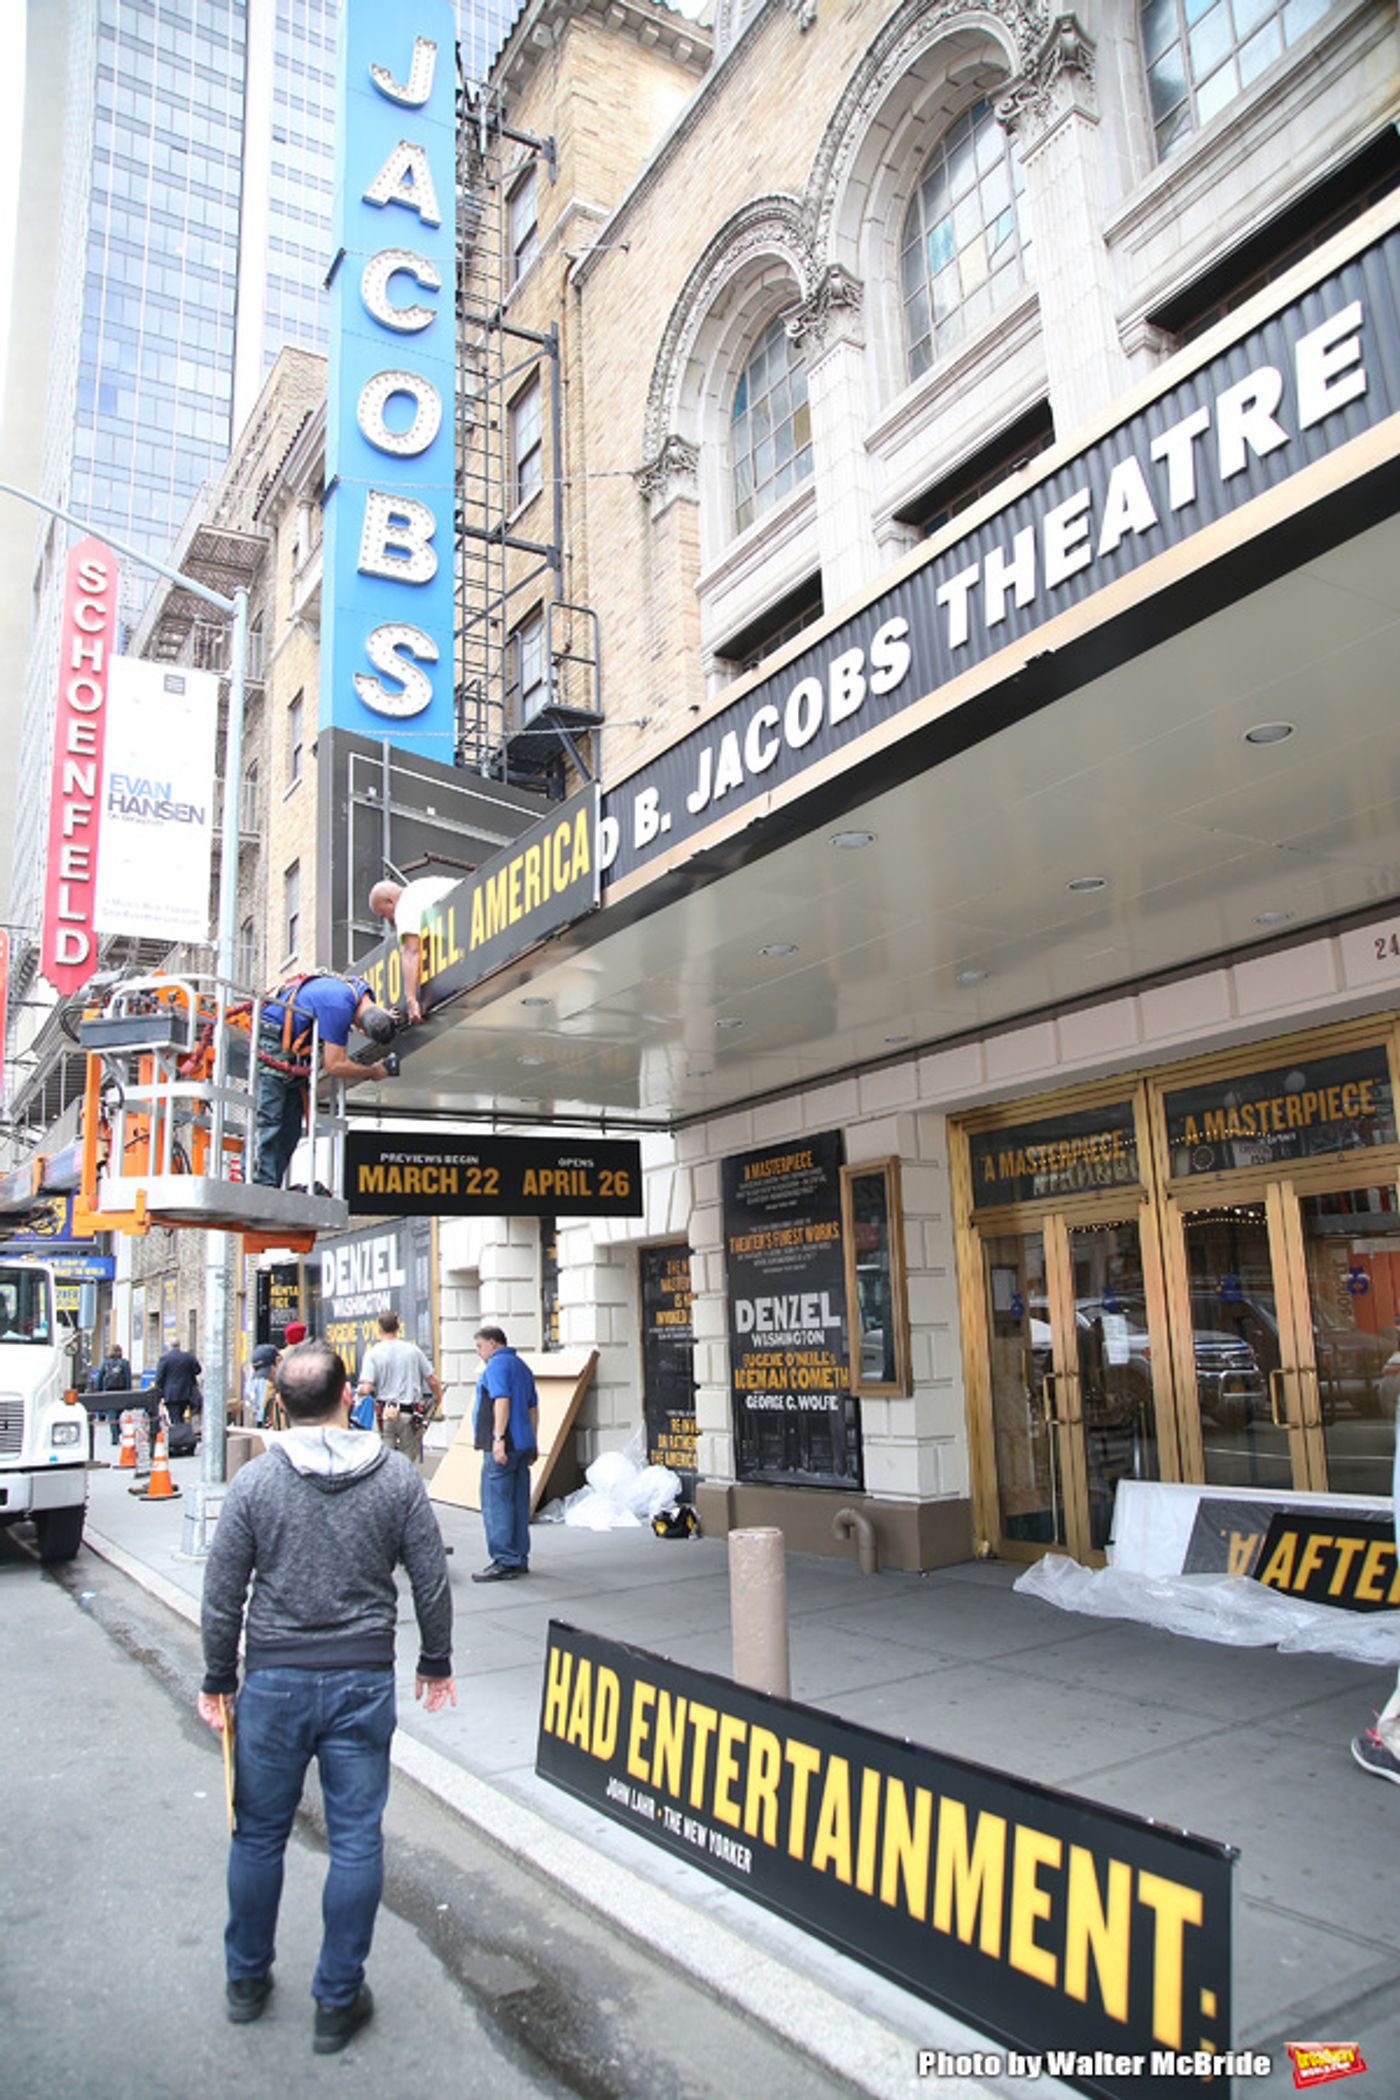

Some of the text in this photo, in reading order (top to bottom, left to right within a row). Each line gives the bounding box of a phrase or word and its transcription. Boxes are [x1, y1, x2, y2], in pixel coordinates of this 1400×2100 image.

[353, 36, 442, 718] JACOBS
[634, 787, 671, 849] B.
[686, 616, 912, 814] JACOBS
[935, 300, 1367, 650] THEATRE
[54, 560, 109, 966] SCHOENFELD
[110, 773, 171, 800] EVAN
[107, 792, 205, 825] HANSEN
[470, 807, 590, 950] AMERICA
[380, 1153, 479, 1164] PREVIEWS BEGIN
[557, 1157, 594, 1167] OPENS
[358, 1164, 499, 1195] MARCH 22
[522, 1168, 629, 1197] APRIL 26
[321, 1233, 406, 1299] DENZEL
[735, 1291, 841, 1334] DENZEL
[751, 1330, 825, 1348] WASHINGTON
[735, 1367, 848, 1390] ICEMAN COMETH
[746, 1395, 784, 1411] GEORGE
[798, 1395, 839, 1411] WOLFE
[544, 1647, 620, 1761] HAD
[606, 1776, 631, 1807] JOHN
[663, 1805, 683, 1835] THE
[683, 1815, 708, 1848] NEW
[709, 1829, 752, 1874] YORKER
